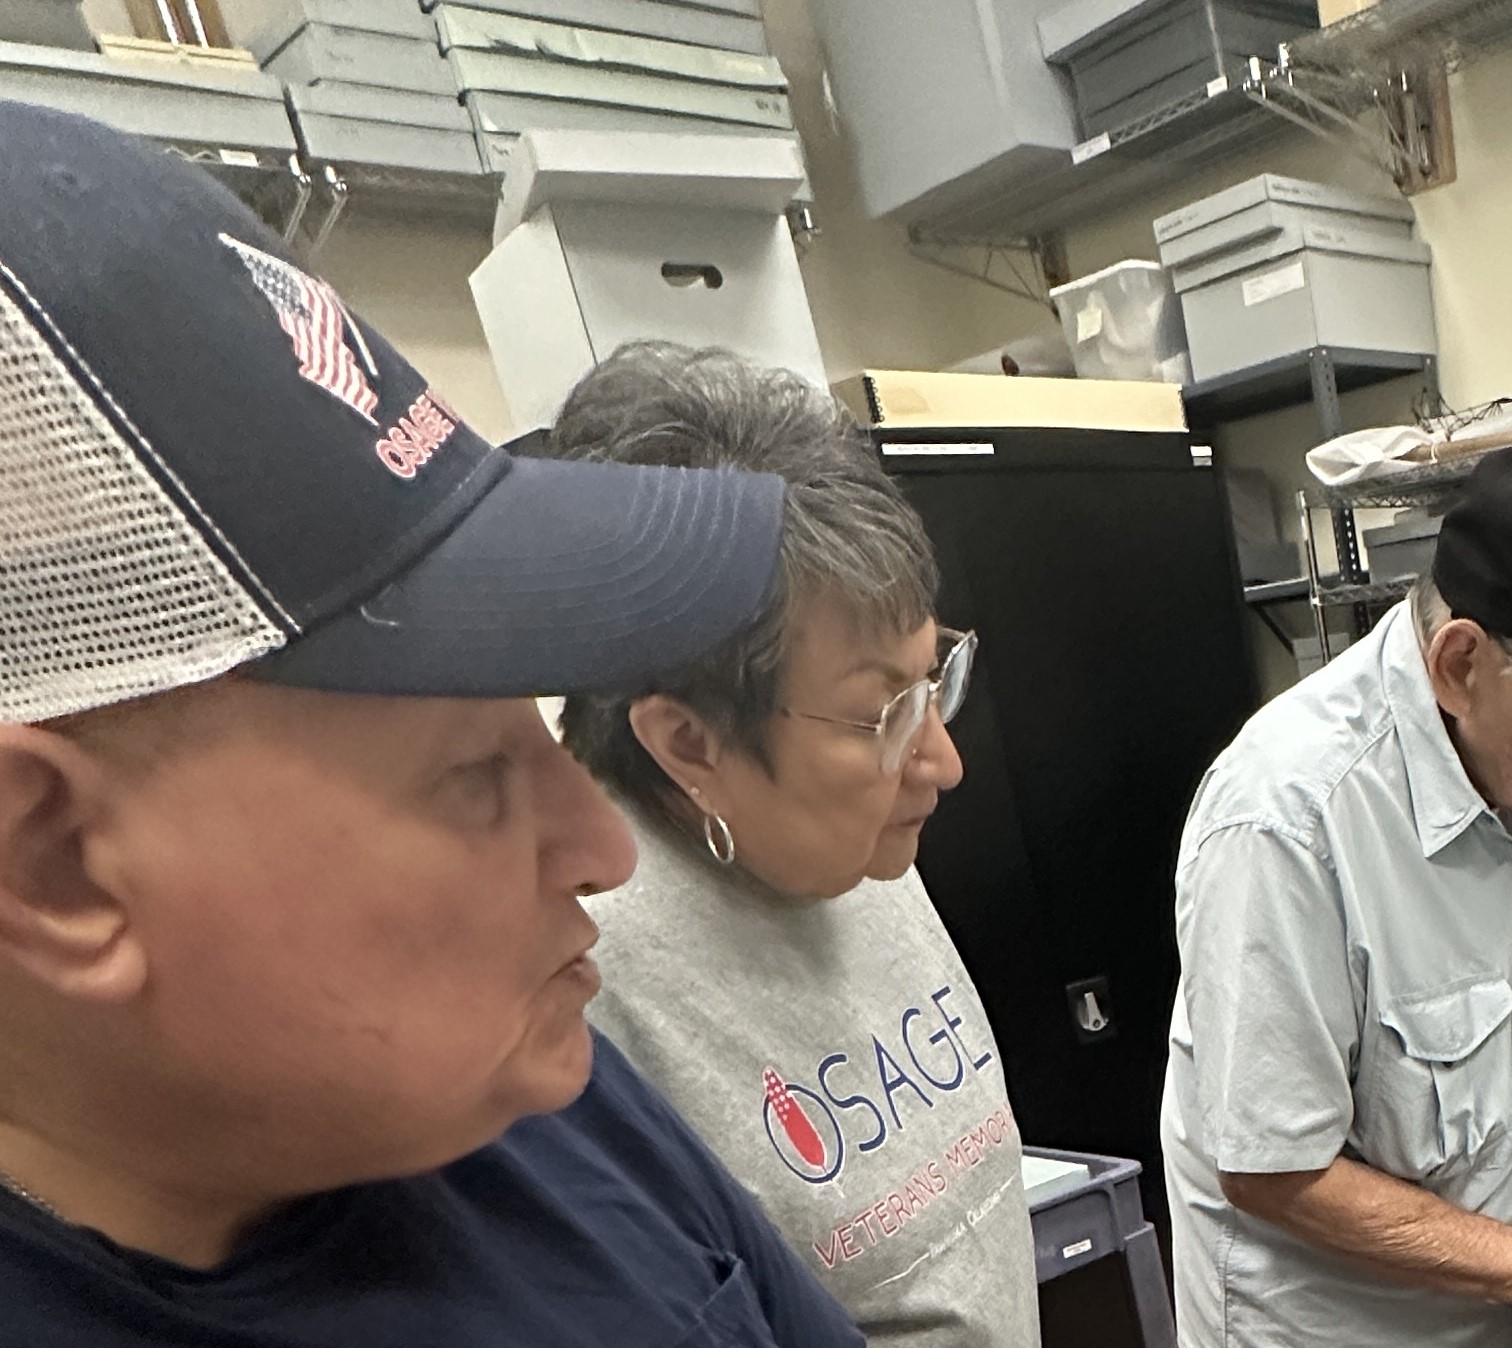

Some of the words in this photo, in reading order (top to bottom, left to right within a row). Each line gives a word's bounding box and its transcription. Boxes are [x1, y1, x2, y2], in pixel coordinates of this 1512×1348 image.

[376, 393, 454, 478] OSAGE
[763, 985, 992, 1184] OSAGE
[813, 1162, 947, 1269] VETERANS
